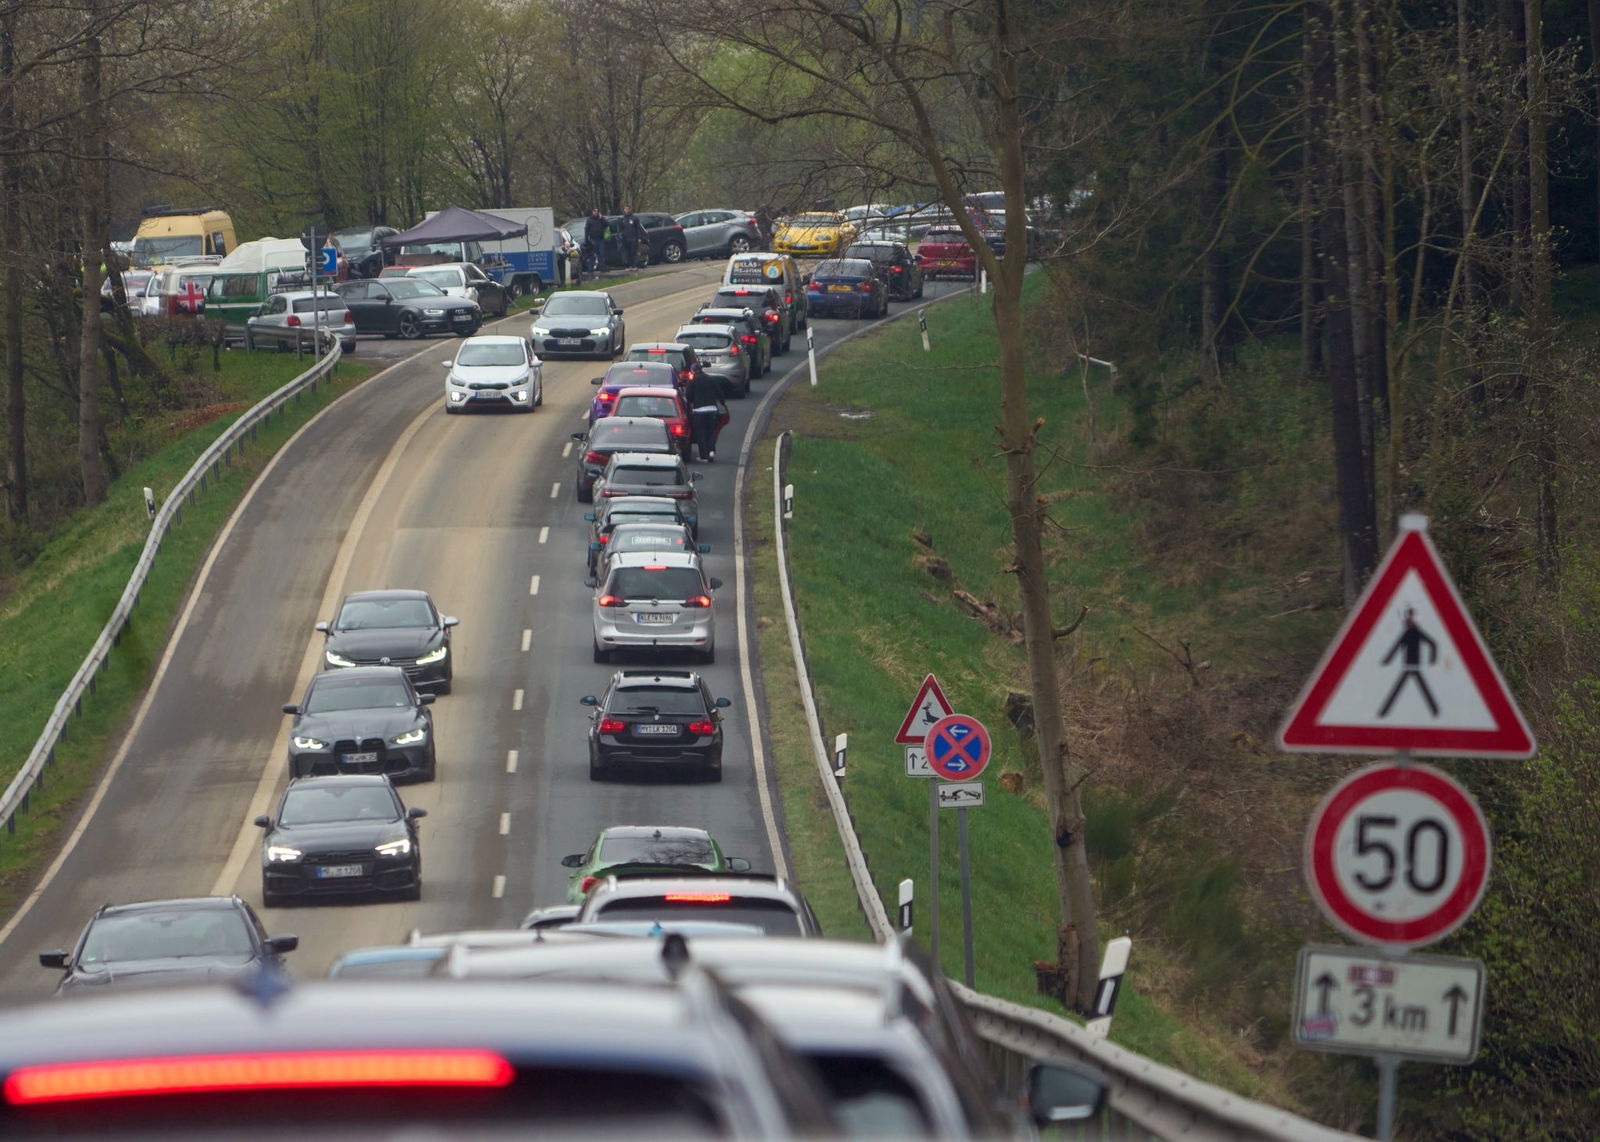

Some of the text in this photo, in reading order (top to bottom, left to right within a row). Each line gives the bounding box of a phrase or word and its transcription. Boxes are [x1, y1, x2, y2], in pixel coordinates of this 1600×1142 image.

[1353, 815, 1448, 895] 50
[1351, 986, 1377, 1027] 3
[1383, 993, 1428, 1033] km
